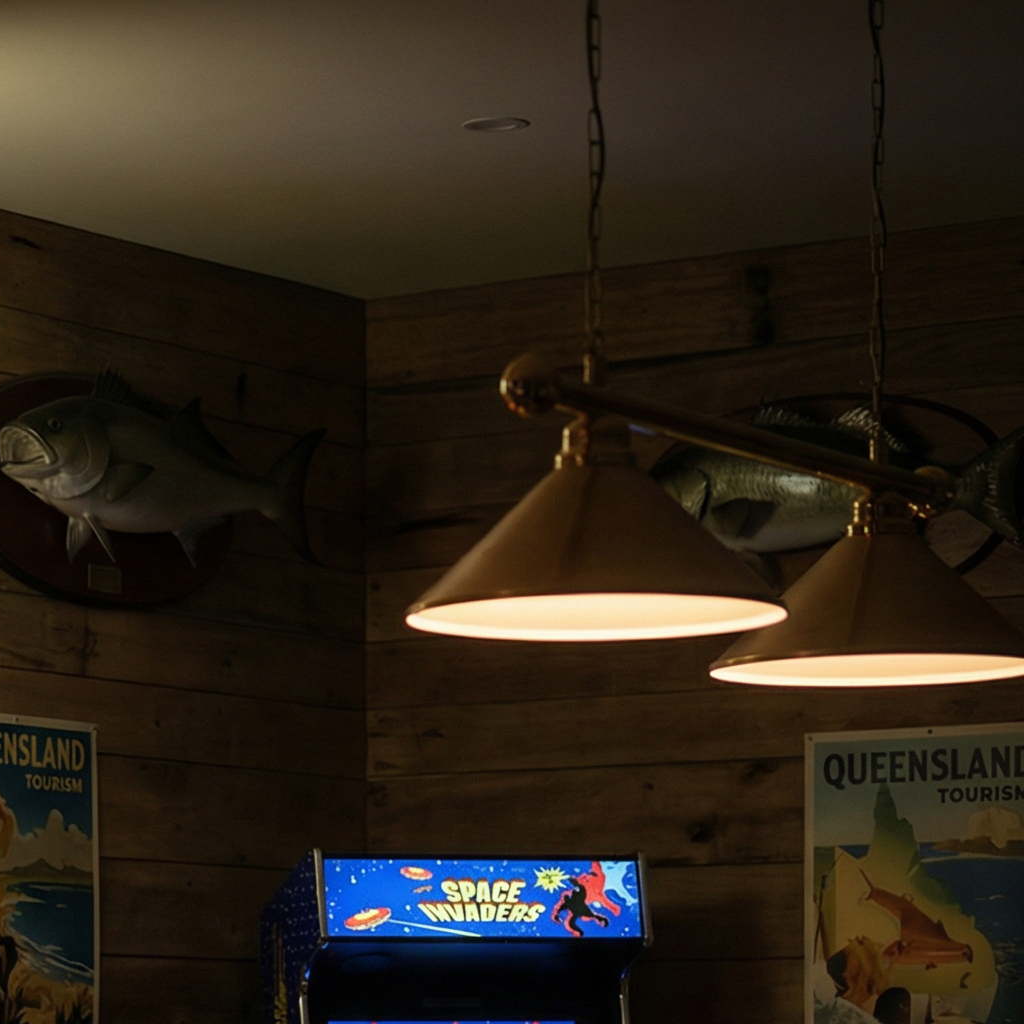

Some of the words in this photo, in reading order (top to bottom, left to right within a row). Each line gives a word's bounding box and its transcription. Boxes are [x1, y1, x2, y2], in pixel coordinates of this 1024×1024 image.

[25, 773, 83, 794] TOURISM
[440, 876, 527, 903] SPACE
[417, 900, 547, 923] INVADERS
